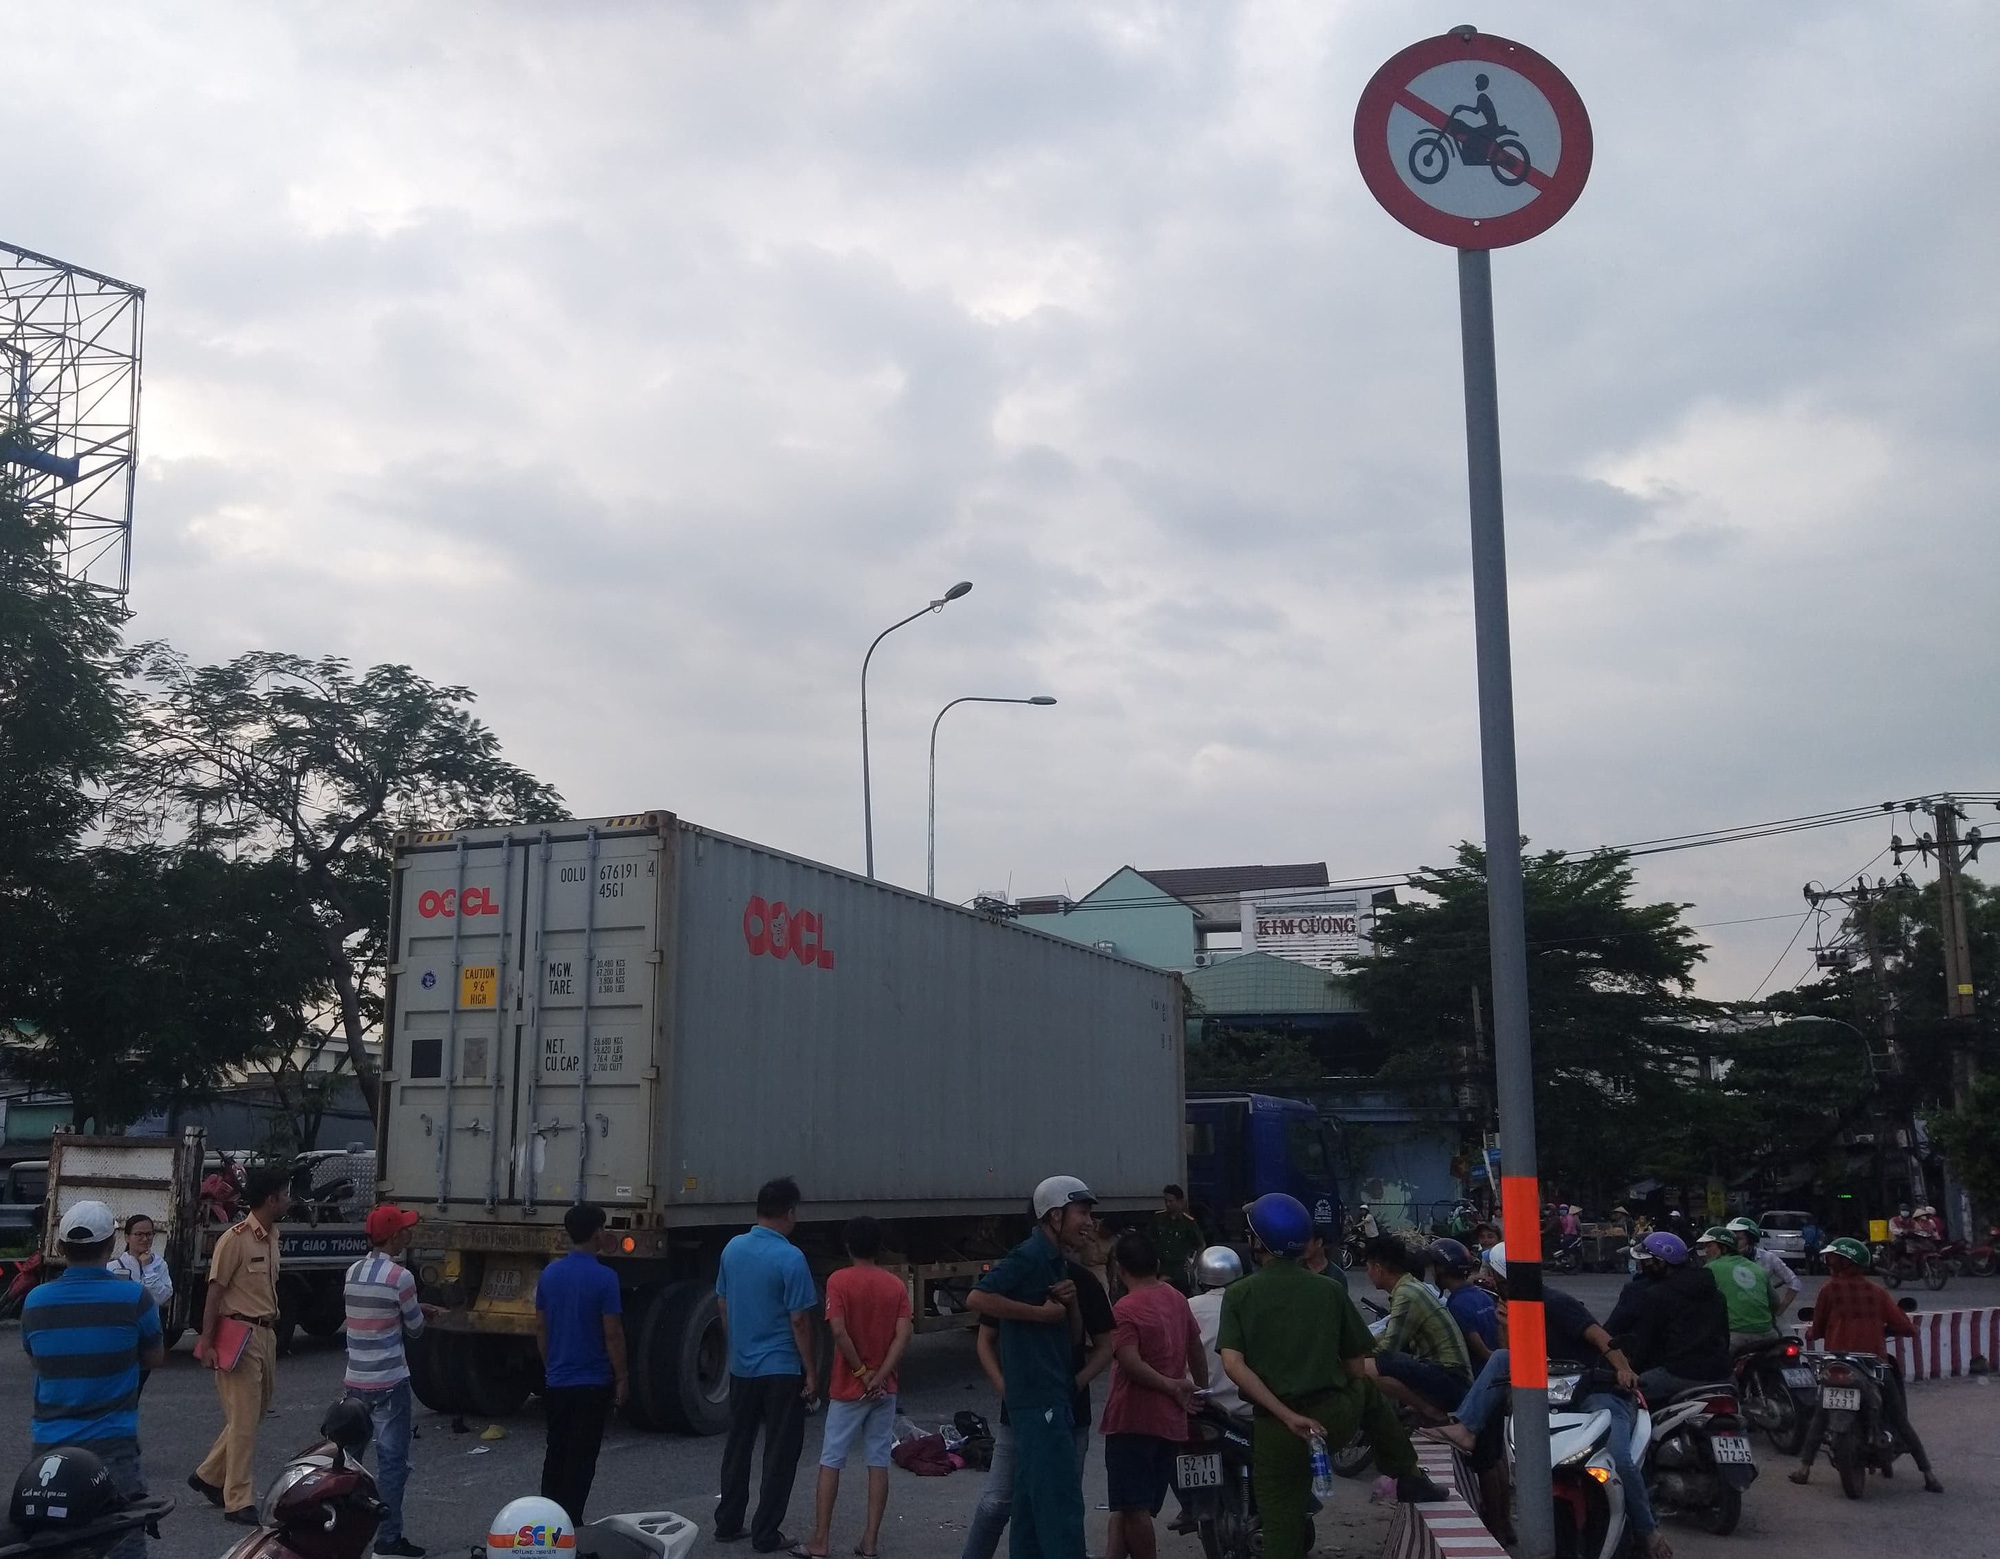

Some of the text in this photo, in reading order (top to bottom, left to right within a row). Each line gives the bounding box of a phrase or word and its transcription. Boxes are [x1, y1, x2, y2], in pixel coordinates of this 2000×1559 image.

[599, 863, 638, 881] 676191
[647, 861, 656, 877] 4
[598, 882, 625, 898] 45G1
[743, 894, 834, 970] OOCL
[1257, 919, 1296, 936] KIM
[465, 968, 495, 980] CAUTION
[549, 961, 574, 978] MGW.
[615, 968, 626, 976] LBS
[548, 979, 575, 995] TARE.
[615, 976, 625, 984] KGS
[615, 985, 625, 993] LBS
[470, 993, 487, 1005] HIGH
[545, 1038, 566, 1054] NET.
[613, 1037, 623, 1045] KGS
[613, 1046, 623, 1054] LBS
[302, 1239, 328, 1251] GIAO
[330, 1238, 368, 1251] THÔNG
[1839, 1244, 1858, 1257] Grab
[1183, 1455, 1214, 1471] 52-Y1
[1184, 1470, 1216, 1487] 8049
